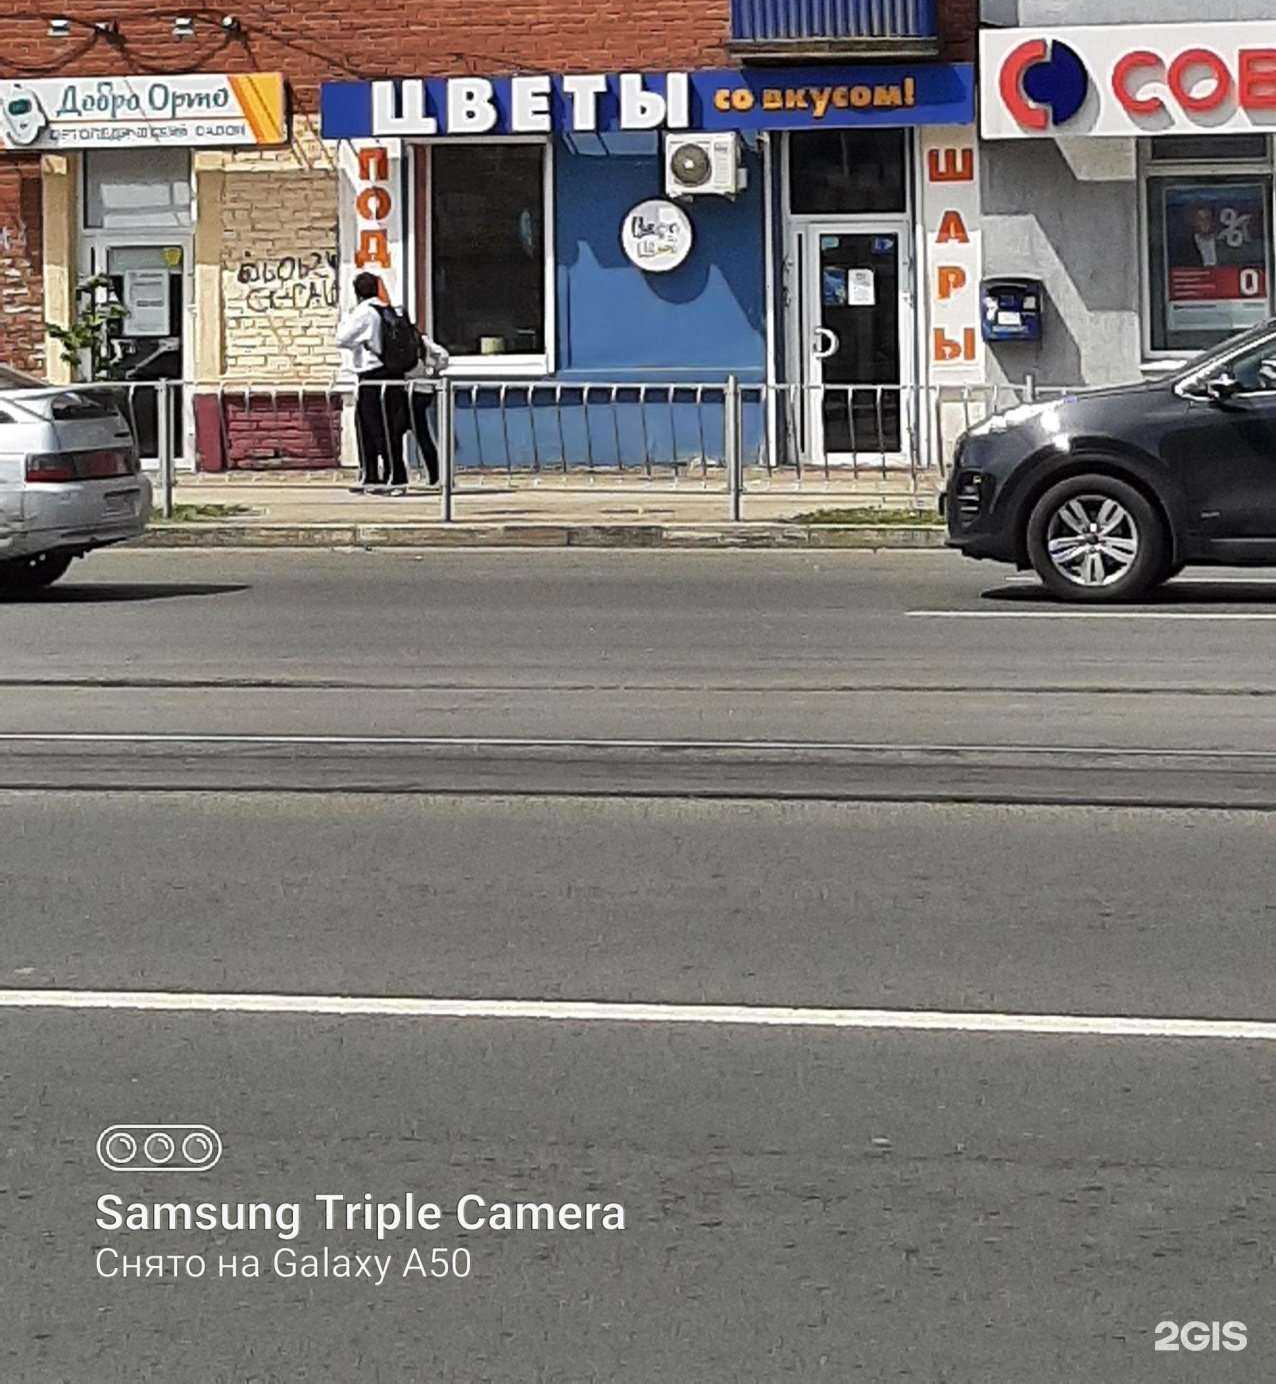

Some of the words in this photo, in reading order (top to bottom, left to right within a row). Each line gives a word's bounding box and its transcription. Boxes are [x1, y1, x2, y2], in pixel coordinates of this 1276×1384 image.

[56, 81, 140, 118] Добро
[148, 83, 228, 119] Орто
[371, 72, 689, 136] ЦВЕТЫ
[713, 88, 755, 110] со
[762, 77, 915, 118] вкусом!
[928, 148, 976, 361] ШАРЫ
